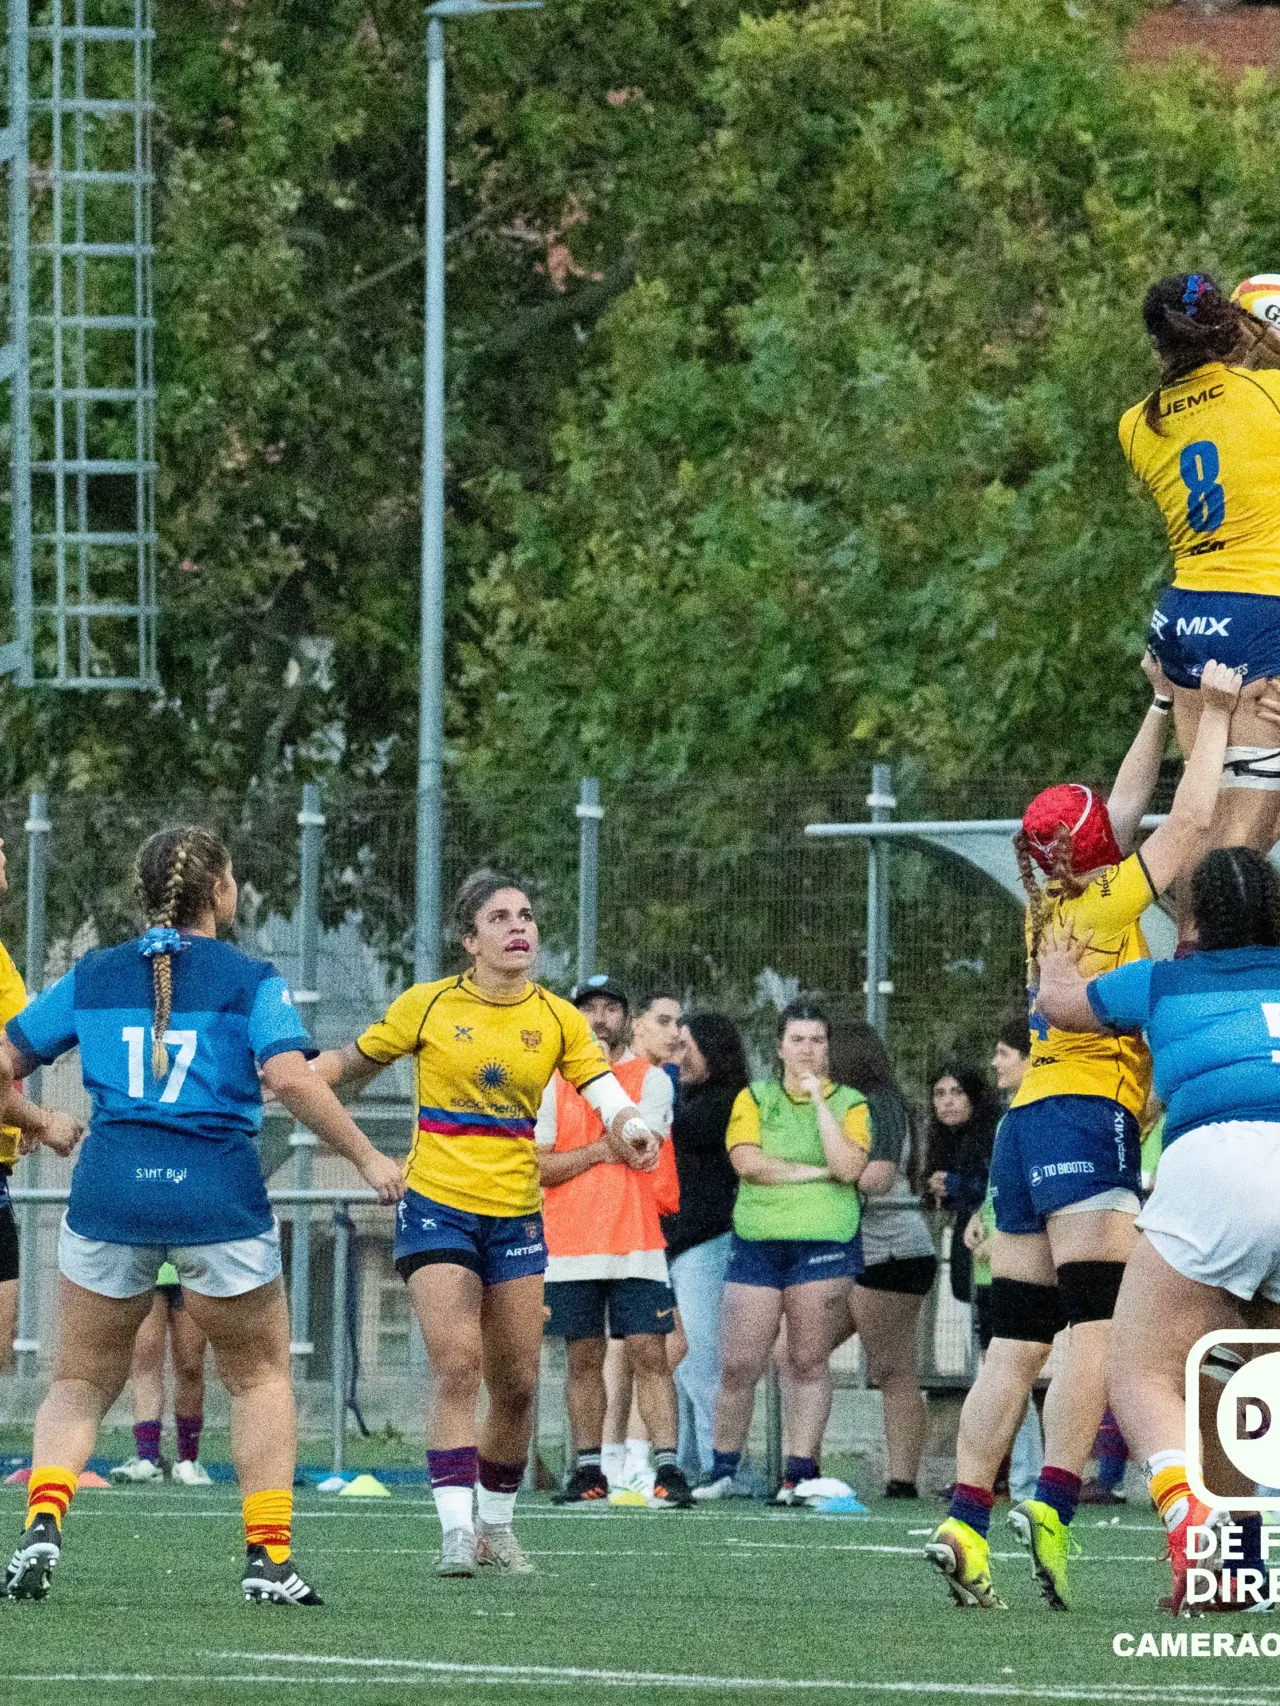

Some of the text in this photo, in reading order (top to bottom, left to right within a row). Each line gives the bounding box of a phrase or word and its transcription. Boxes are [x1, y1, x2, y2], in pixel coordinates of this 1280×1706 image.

[1180, 440, 1225, 533] 8
[122, 1026, 198, 1103] 17
[136, 1168, 163, 1179] SANT
[1058, 1161, 1095, 1175] BIGOTES
[505, 1243, 543, 1258] ARTERO
